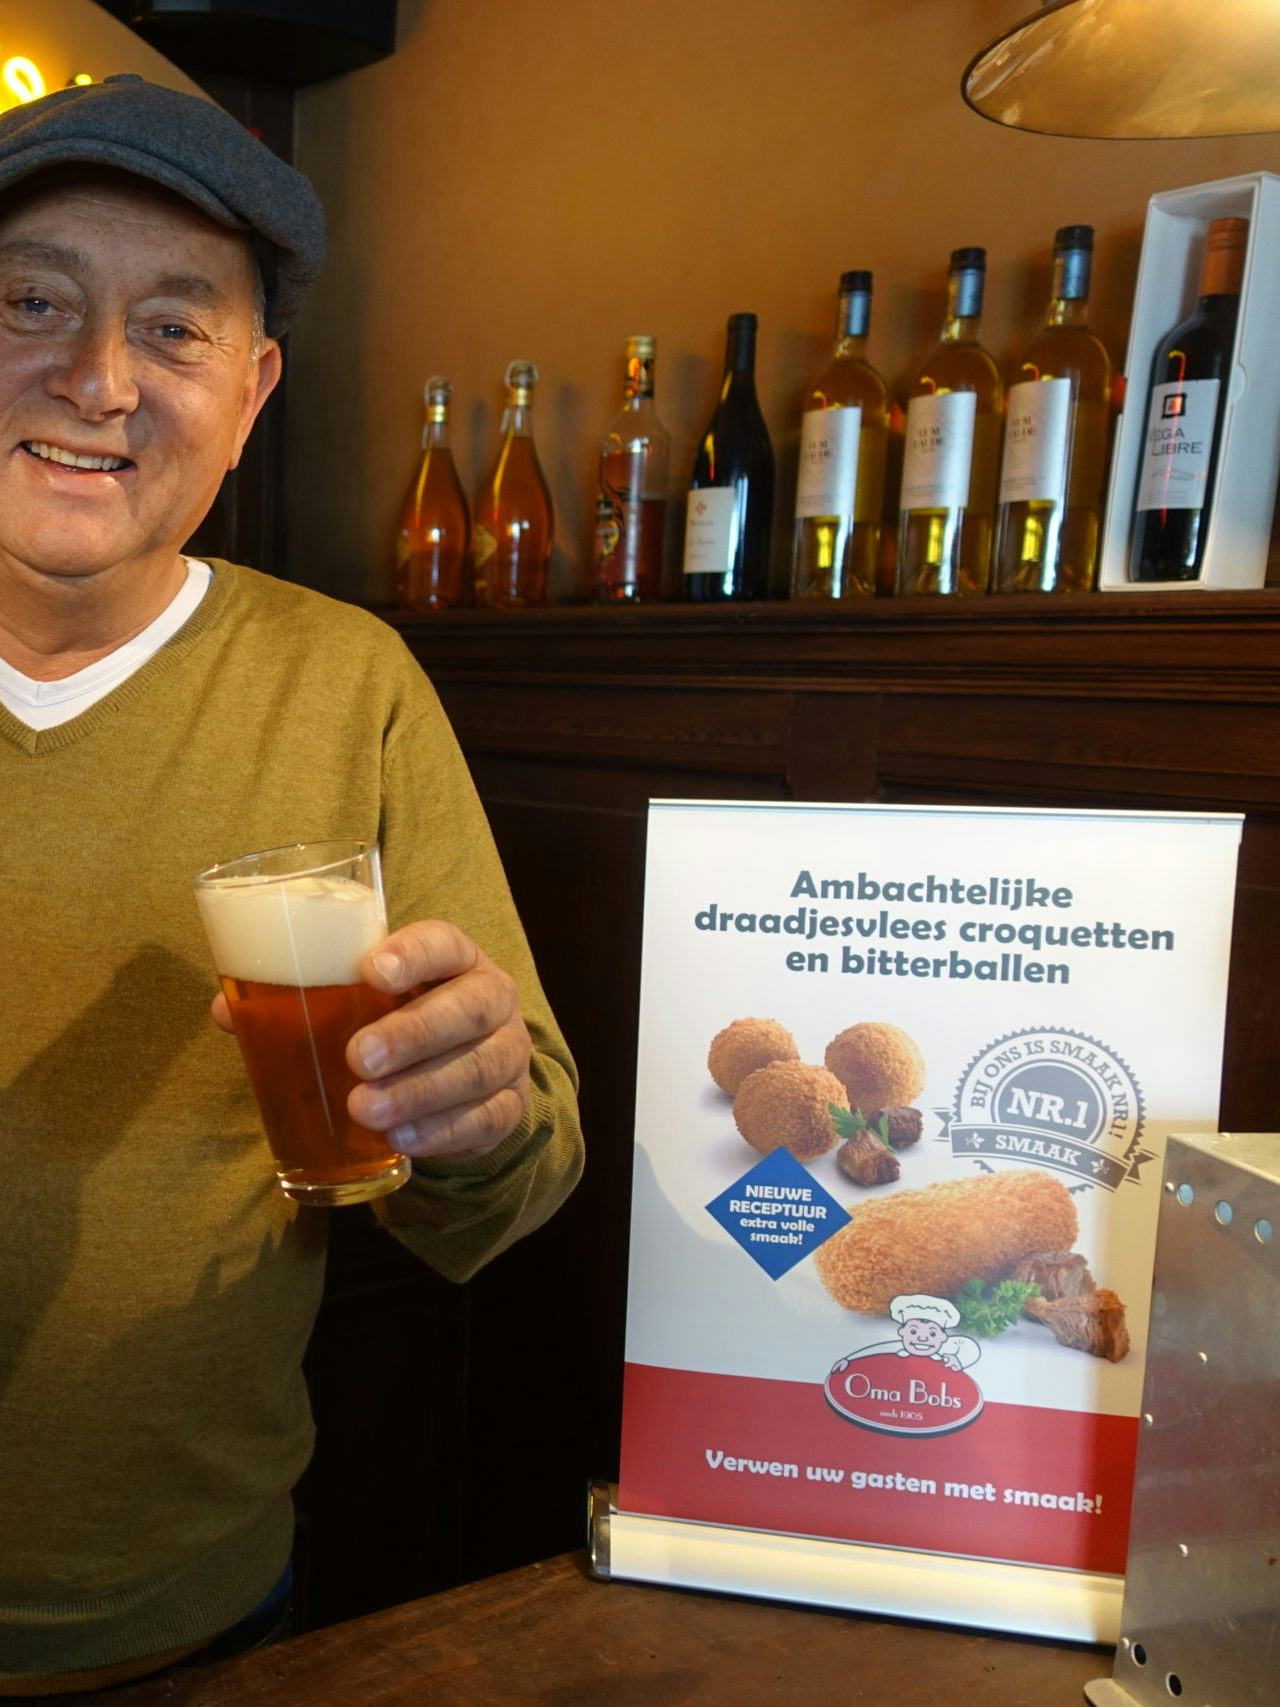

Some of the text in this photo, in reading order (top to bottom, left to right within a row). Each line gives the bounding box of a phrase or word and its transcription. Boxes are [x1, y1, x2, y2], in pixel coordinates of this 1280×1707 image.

[1152, 441, 1204, 457] LIBRE
[790, 870, 1073, 911] Ambachtelijke
[694, 903, 1174, 951] draadjesvlees croquetten
[785, 945, 1070, 984] en bitterballen
[970, 1079, 993, 1108] BIJ
[984, 1046, 1022, 1078] ONS
[1023, 1040, 1045, 1056] IS
[1050, 1040, 1123, 1090] SMAAK
[1007, 1087, 1089, 1129] NR.1
[995, 1134, 1082, 1166] SMAAK
[729, 1199, 827, 1219] RECEPTUUR
[745, 1184, 812, 1201] NIEUWE
[740, 1217, 815, 1232] extra volle
[750, 1232, 803, 1245] smaak!
[844, 1373, 962, 1409] Oma Bobs
[900, 1410, 924, 1421] 1905
[705, 1449, 1103, 1515] Verwen uw gasten met smaak!
